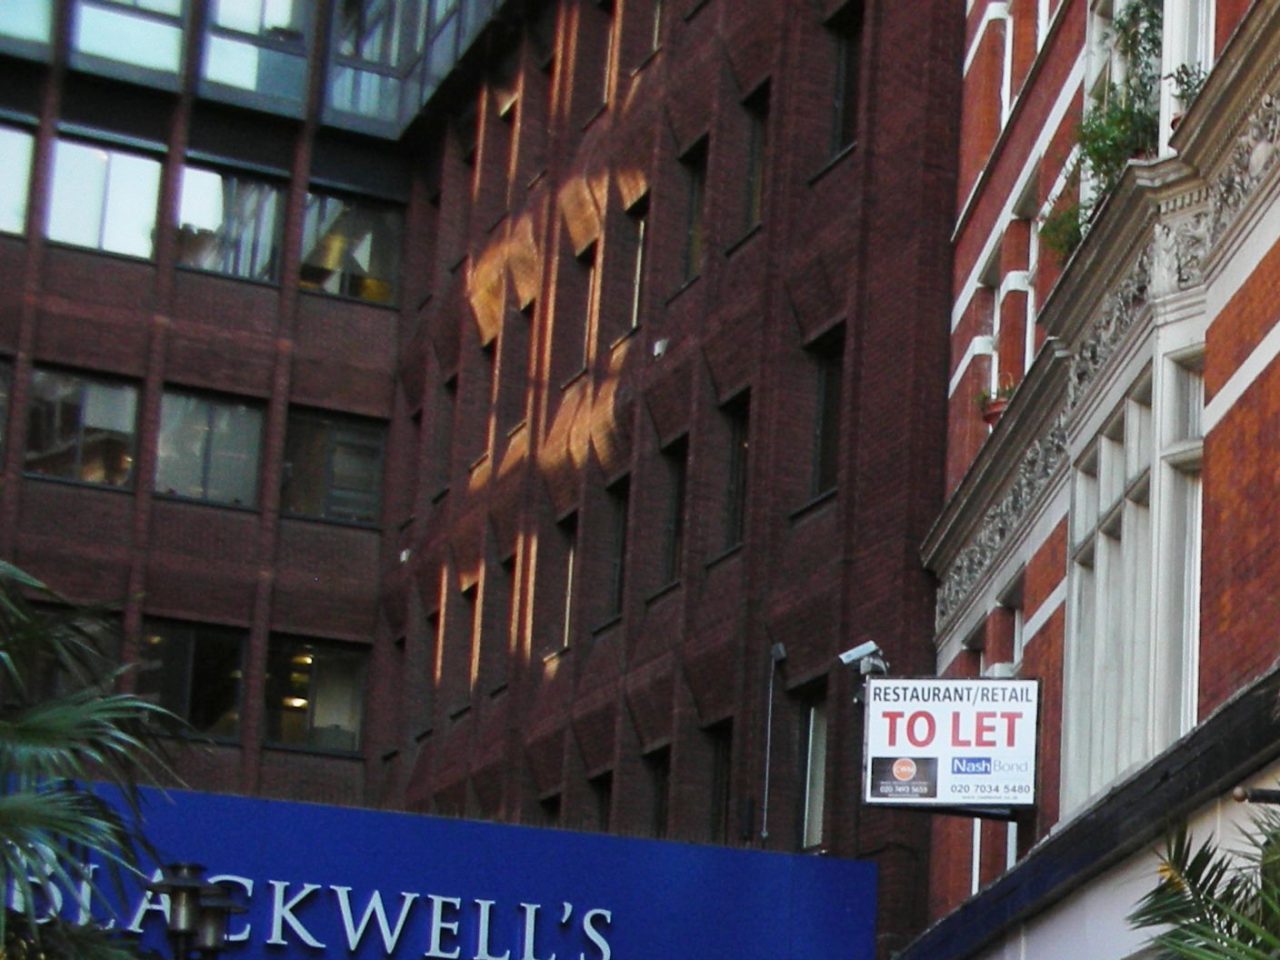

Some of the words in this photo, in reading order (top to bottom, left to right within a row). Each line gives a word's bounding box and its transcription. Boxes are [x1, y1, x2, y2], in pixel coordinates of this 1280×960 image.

[873, 686, 1032, 706] RESTAURANT/RETAIL
[882, 711, 936, 748] TO
[951, 711, 1023, 748] LET
[954, 759, 990, 772] Nash
[994, 760, 1028, 772] Bond
[951, 784, 970, 793] 020
[974, 784, 999, 793] 7034
[1003, 785, 1031, 793] 5480
